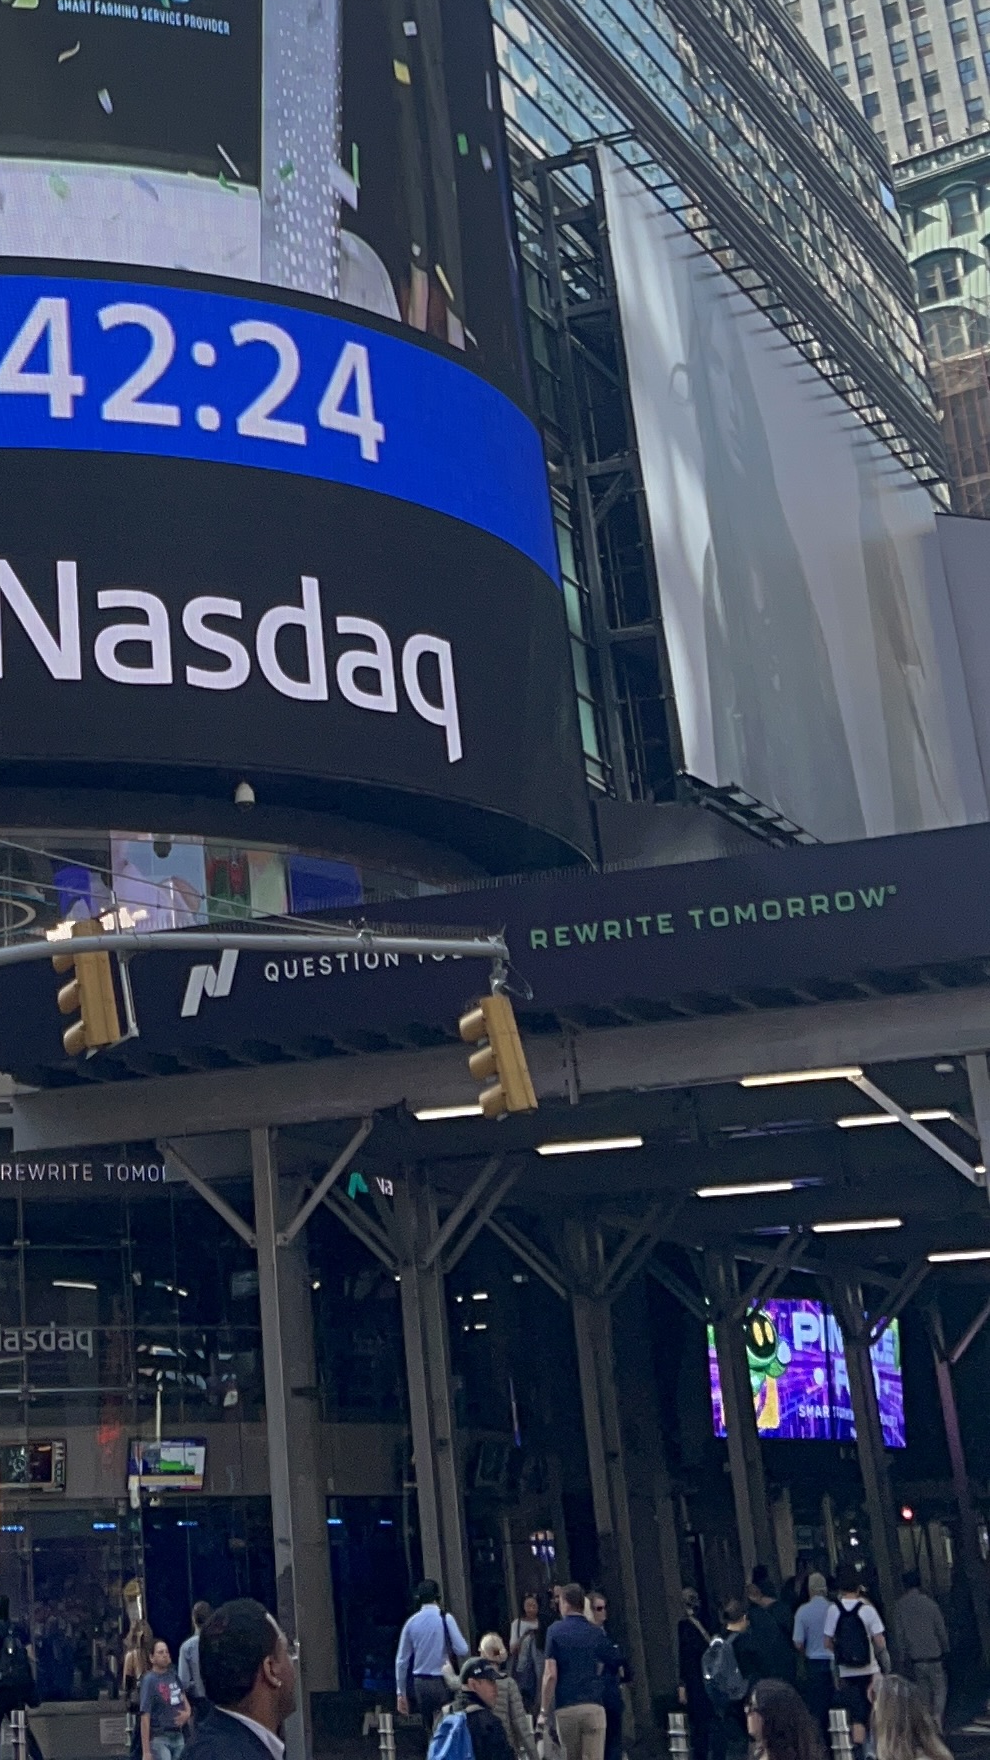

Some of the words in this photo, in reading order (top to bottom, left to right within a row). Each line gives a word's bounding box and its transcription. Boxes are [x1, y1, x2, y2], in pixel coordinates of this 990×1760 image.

[93, 1, 139, 21] FARMING
[140, 6, 182, 27] SERVICE
[183, 12, 231, 37] PROVIDER
[529, 913, 675, 950] REWRITE
[263, 949, 401, 983] QUESTION
[0, 1162, 94, 1182] REWRITE
